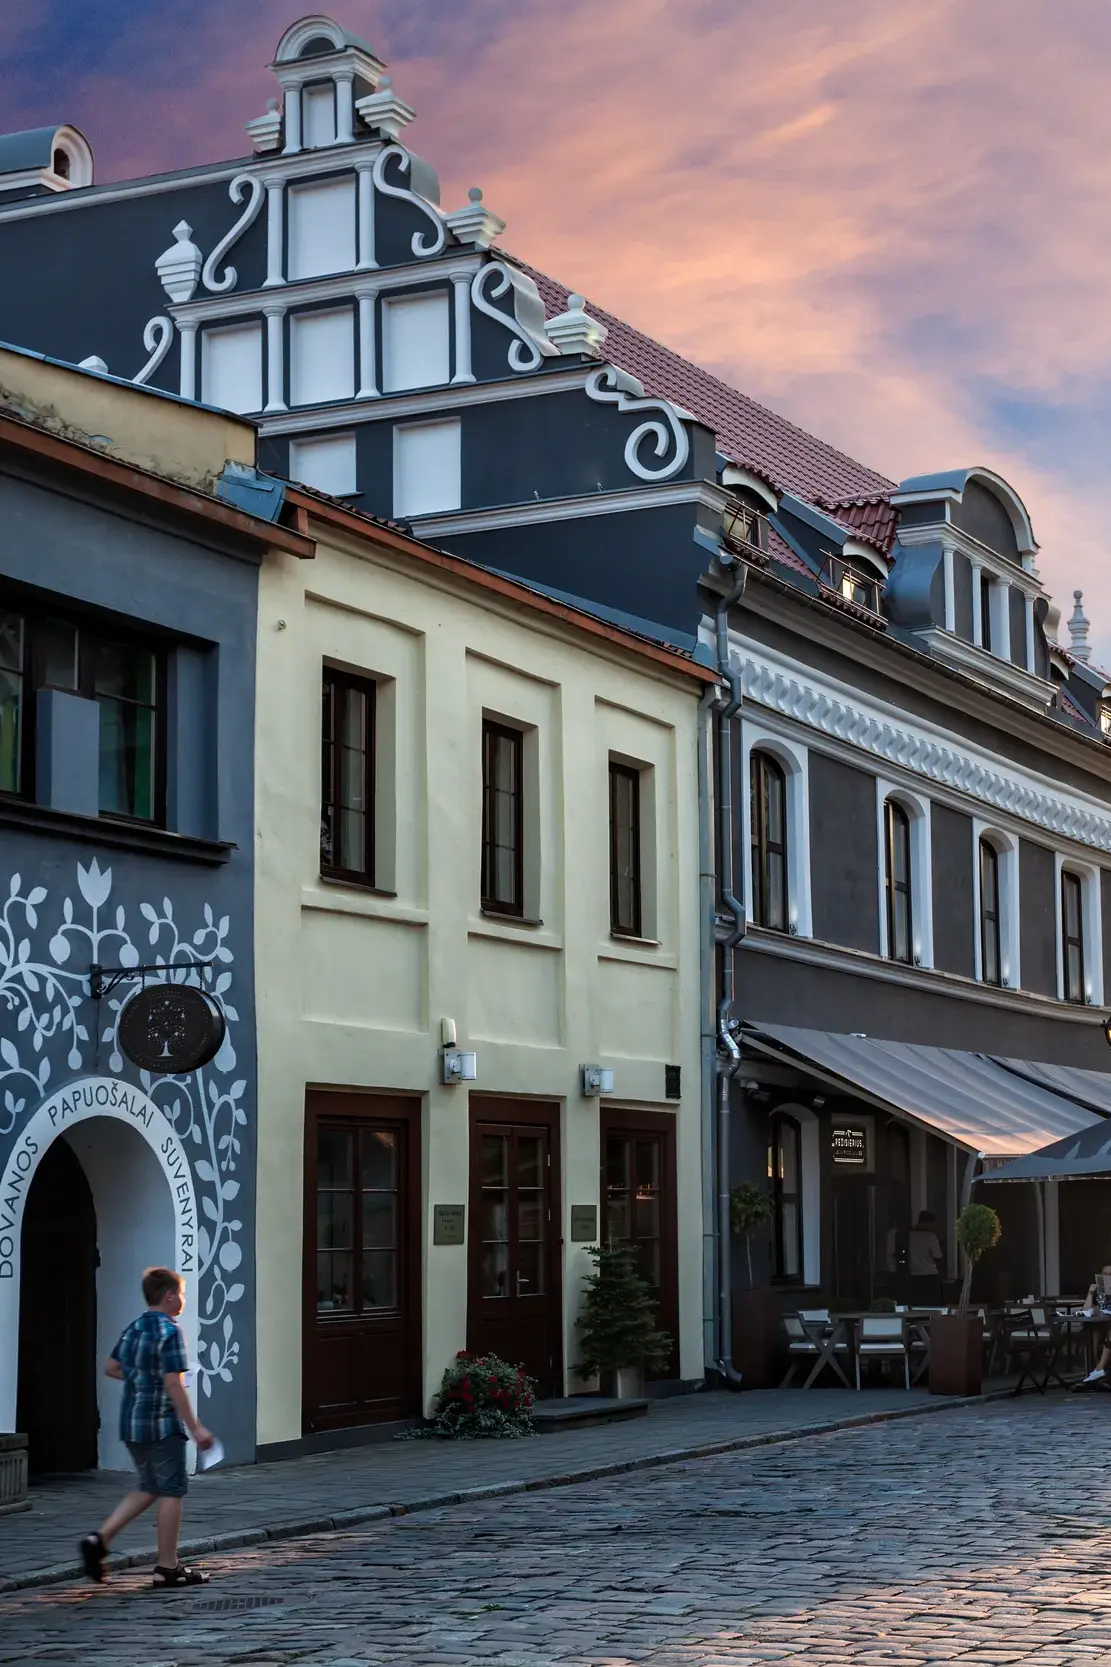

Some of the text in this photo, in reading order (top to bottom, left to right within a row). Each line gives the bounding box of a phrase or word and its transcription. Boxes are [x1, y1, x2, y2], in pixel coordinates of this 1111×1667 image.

[0, 1081, 194, 1279] DOVANOS PAPUOŠALAI SUVENYRAI
